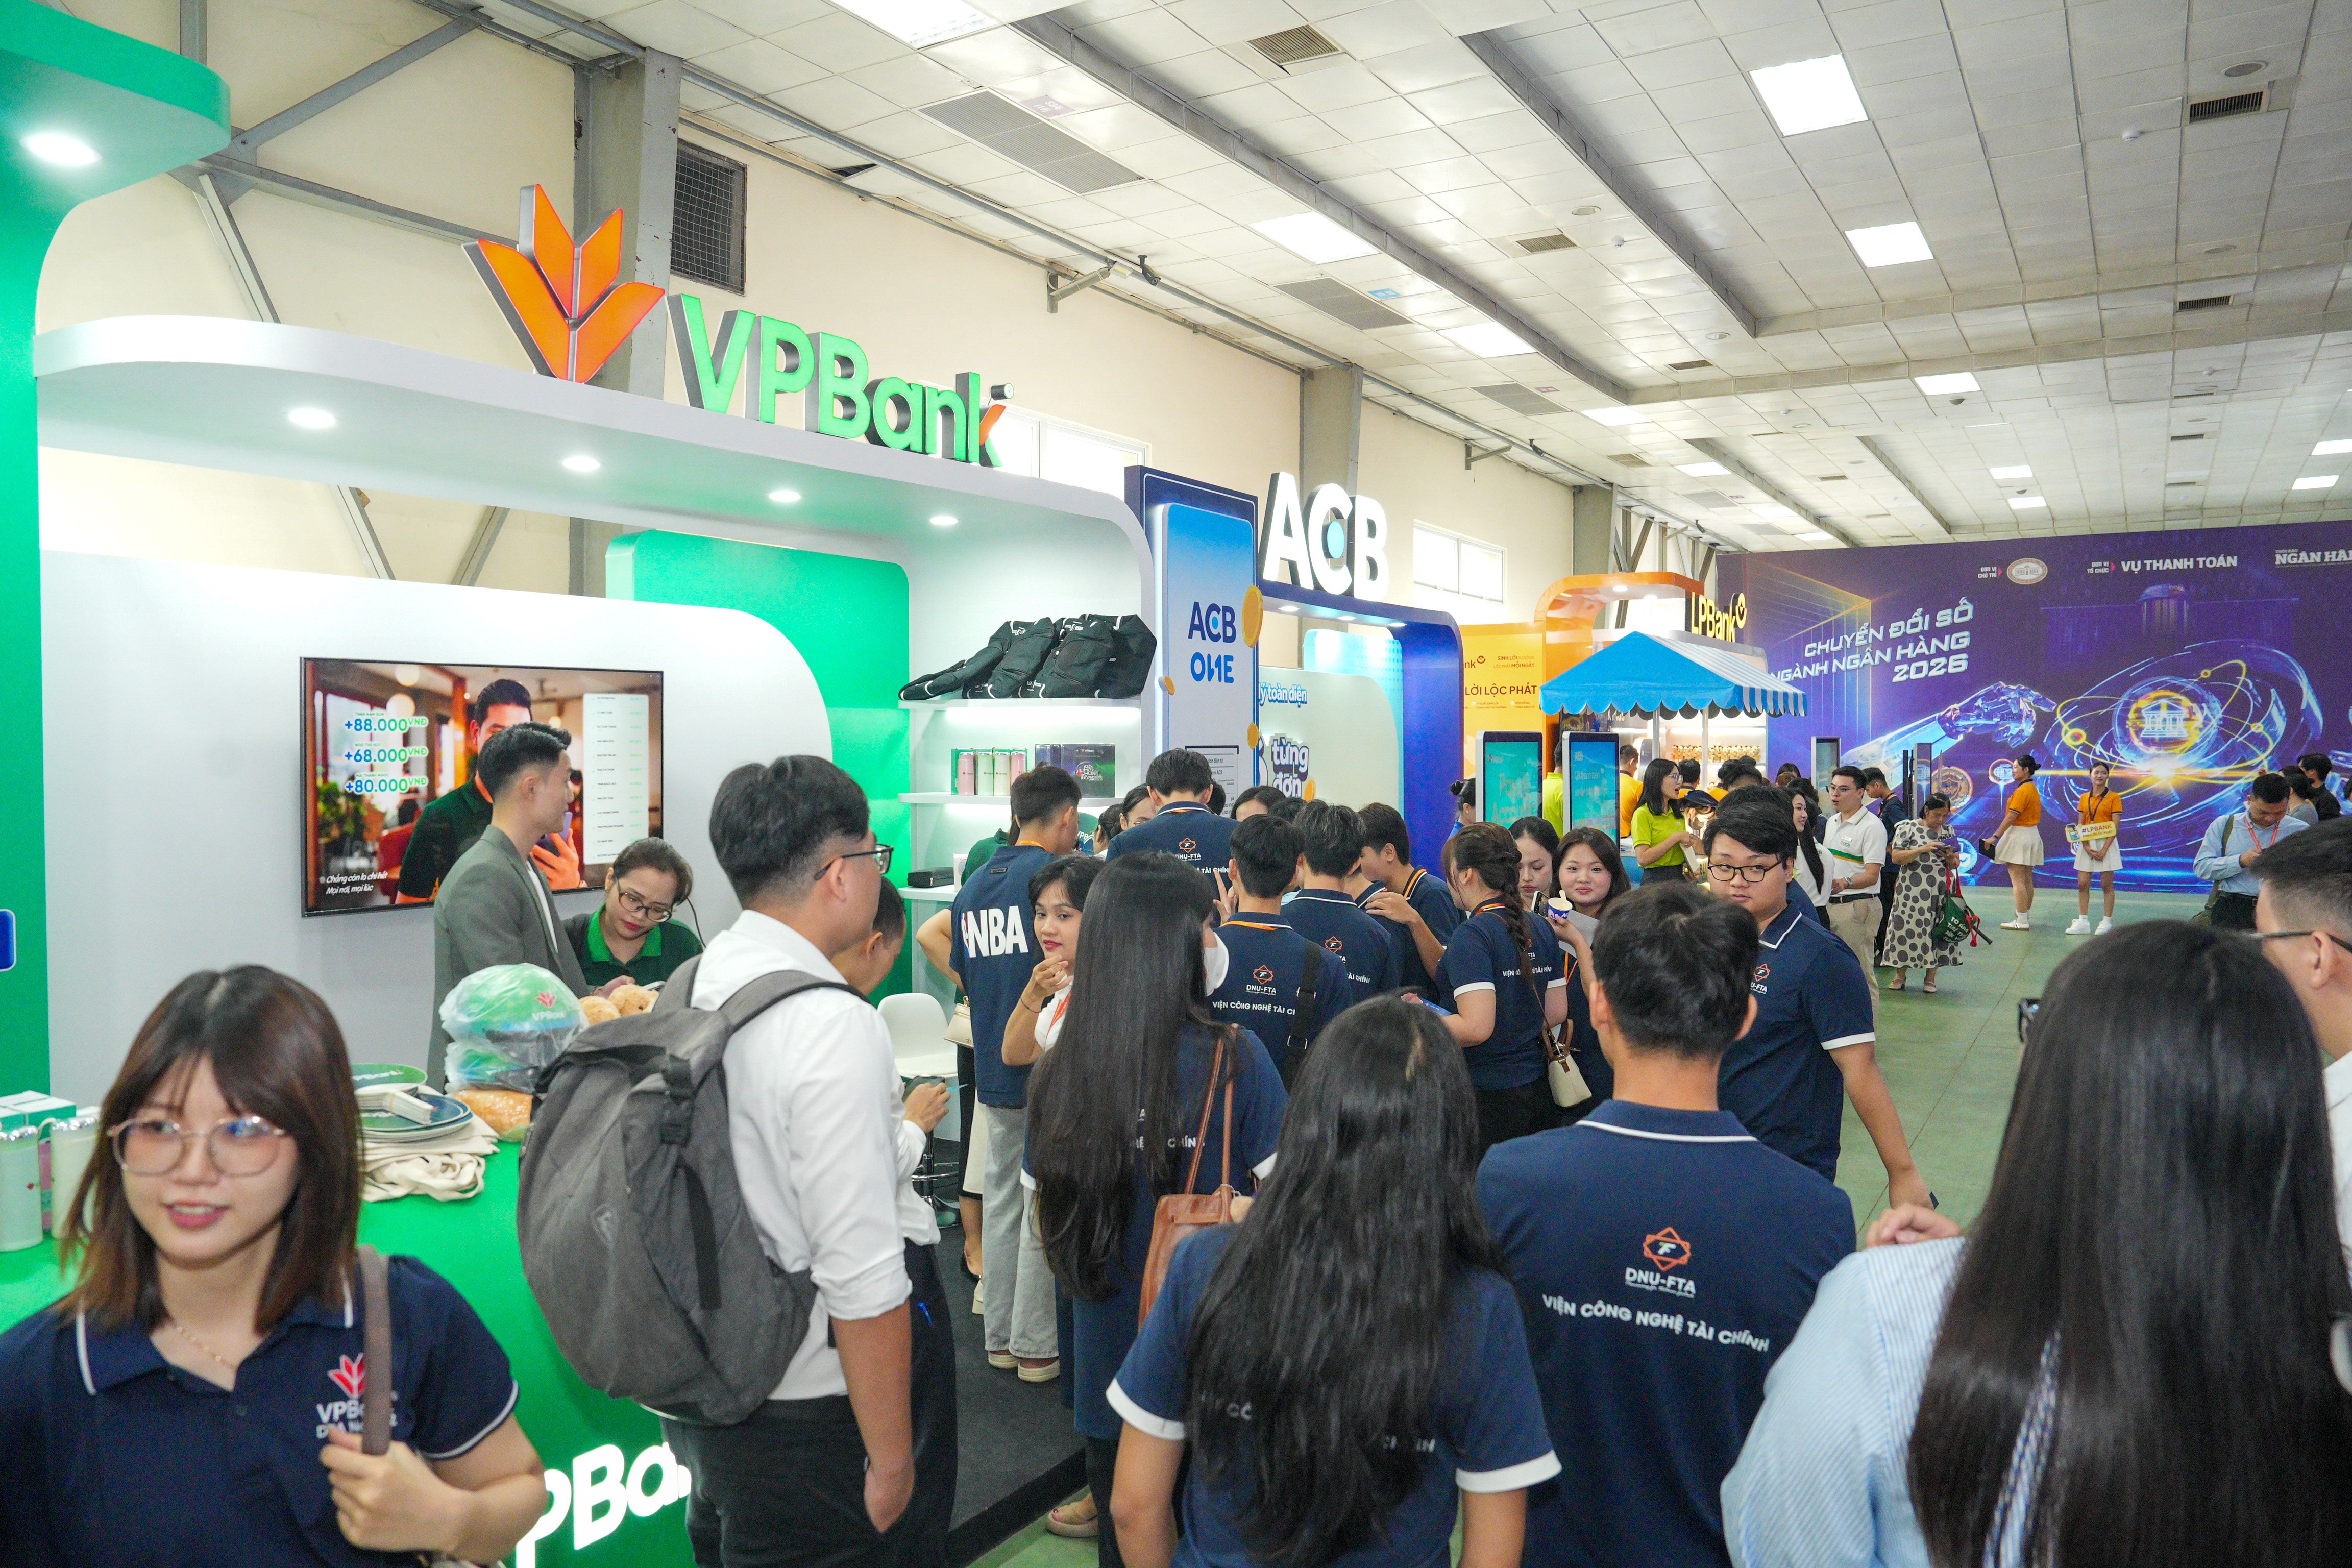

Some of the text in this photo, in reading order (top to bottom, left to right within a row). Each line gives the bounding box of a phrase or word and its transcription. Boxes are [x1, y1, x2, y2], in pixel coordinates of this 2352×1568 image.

[668, 293, 1006, 467] VPBank
[1261, 471, 1389, 602] ACB
[2121, 554, 2238, 574] VỤ THANH TOÁN
[1188, 601, 1236, 643] ACB
[1691, 591, 1735, 643] LPBank
[1804, 597, 1974, 657] CHUYỂN ĐỔI SỐ
[1832, 647, 1892, 673] NGÂN
[1896, 630, 1971, 661] HÀNG
[1892, 653, 1969, 683] 2026
[1267, 682, 1288, 703] toàn
[1289, 684, 1307, 708] diện
[1465, 682, 1537, 698] LỜI LỘC PHÁT
[345, 718, 408, 732] +88.000
[345, 749, 408, 763] +68.000
[1272, 737, 1309, 773] từng
[346, 779, 408, 793] +80.000
[326, 873, 347, 885] Chẳng
[360, 873, 367, 881] lo
[326, 886, 339, 896] Mọi
[351, 885, 364, 894] mọi
[967, 905, 1028, 958] NBA
[1246, 984, 1277, 994] DNU-FTA
[1750, 982, 1768, 992] U-FTA
[1212, 1000, 1229, 1010] VIỆN
[1230, 1000, 1251, 1010] CÔNG
[1252, 1003, 1272, 1013] NGHỆ
[1273, 1005, 1285, 1014] TÀI
[1625, 1267, 1696, 1294] DNU-FTA
[1542, 1293, 1770, 1352] VIỆN CÔNG NGHỆ TÀI CHÍNH
[516, 1442, 692, 1568] PBa
